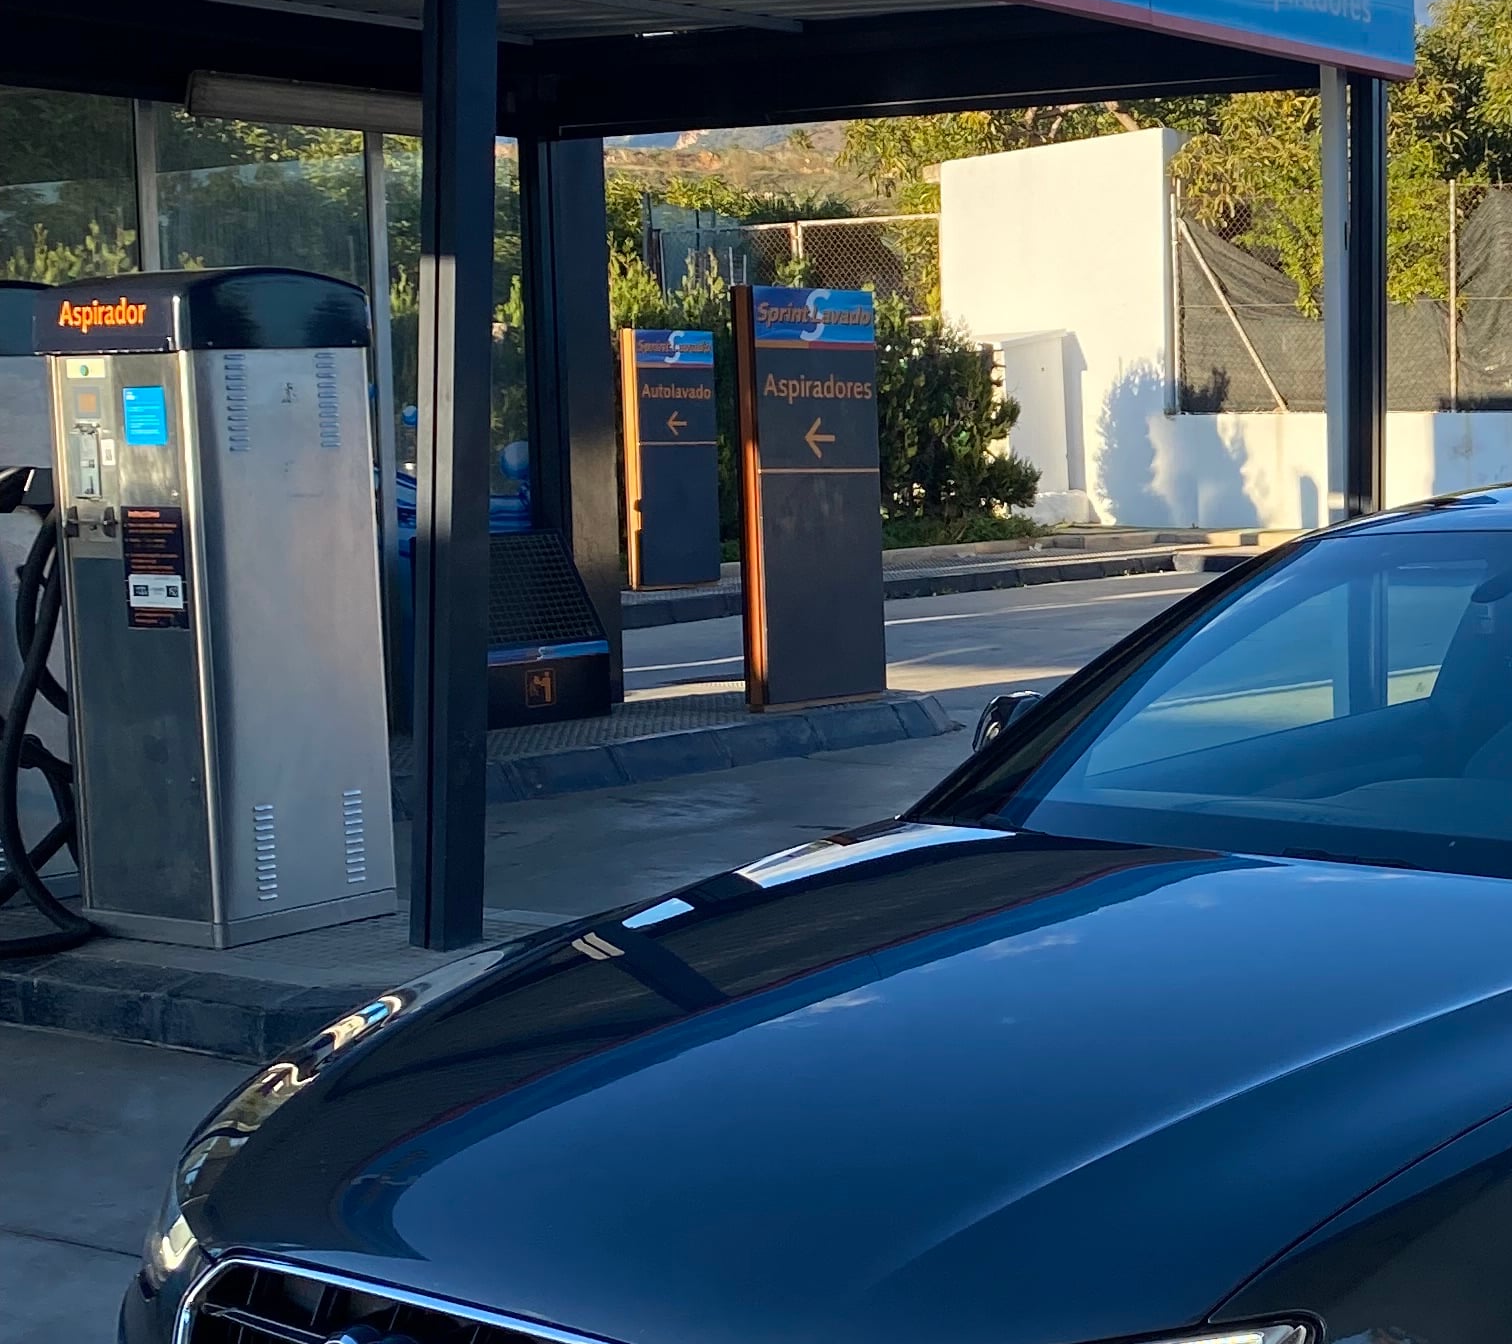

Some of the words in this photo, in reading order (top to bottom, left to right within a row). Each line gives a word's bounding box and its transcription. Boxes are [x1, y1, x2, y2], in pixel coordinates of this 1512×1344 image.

[58, 296, 147, 334] Aspirador
[757, 302, 810, 328] Sprint
[811, 304, 872, 326] Lavado
[642, 383, 712, 400] Autolavado
[764, 373, 873, 405] Aspiradores
